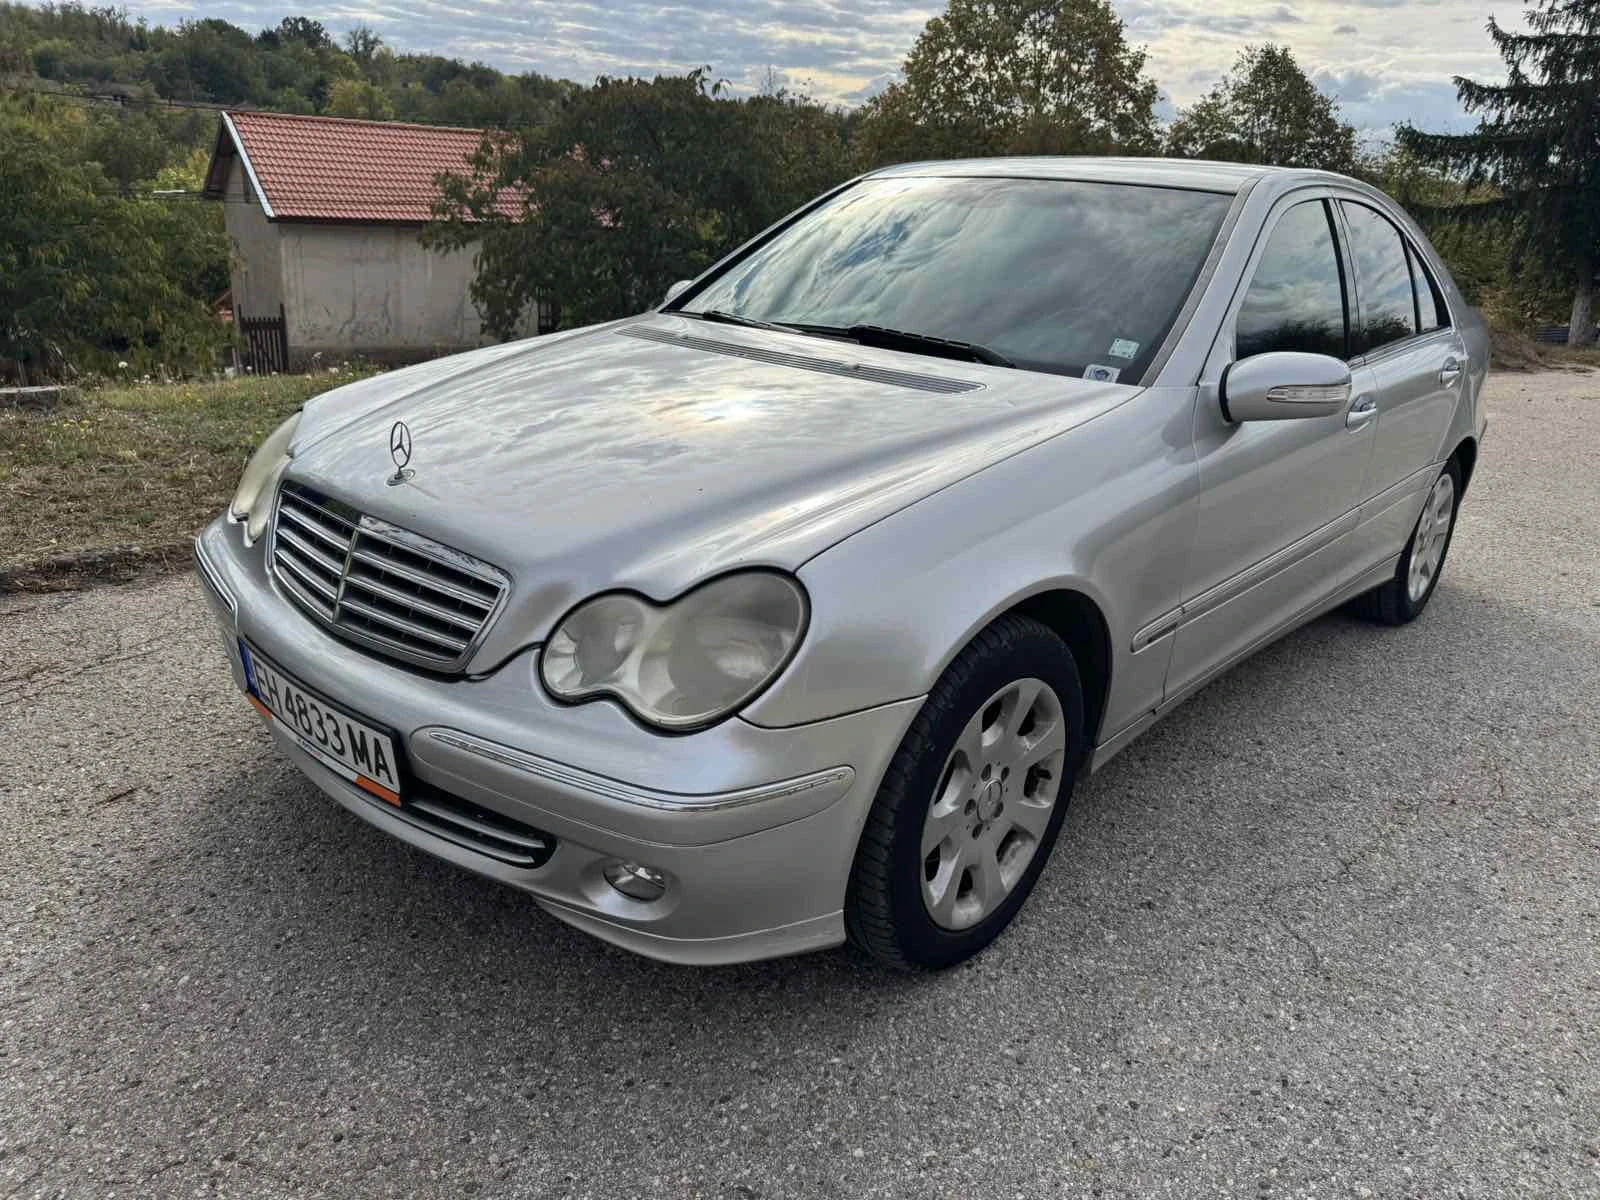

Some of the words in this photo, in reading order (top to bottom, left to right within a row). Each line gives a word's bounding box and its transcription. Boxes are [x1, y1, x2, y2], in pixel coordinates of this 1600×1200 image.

[253, 658, 283, 716] EH
[286, 686, 346, 756] 4833
[347, 723, 394, 785] MA
